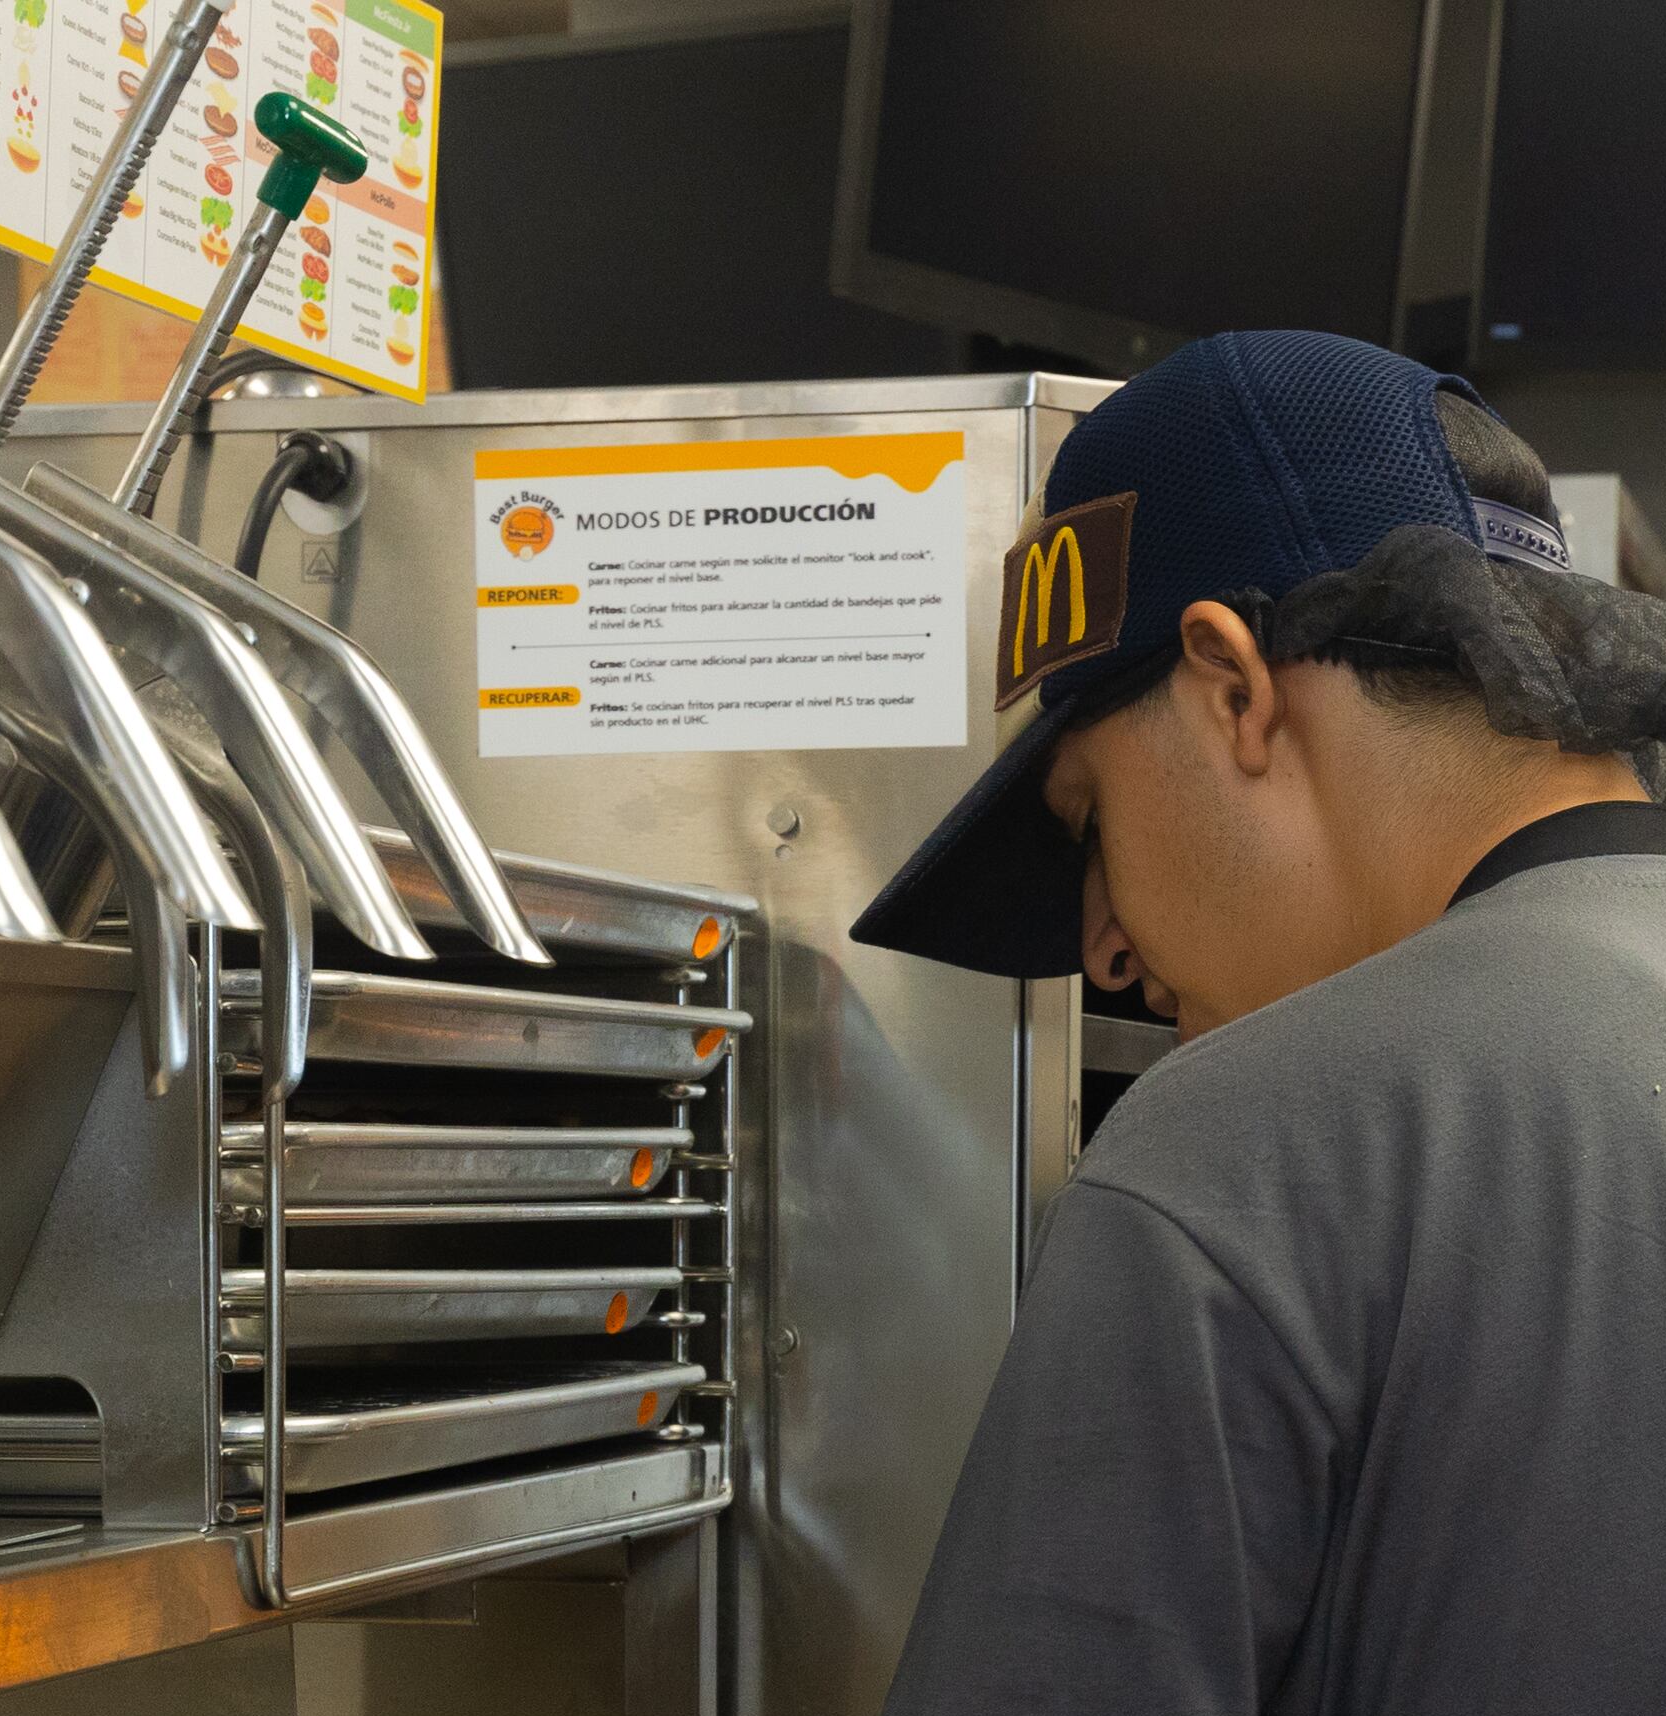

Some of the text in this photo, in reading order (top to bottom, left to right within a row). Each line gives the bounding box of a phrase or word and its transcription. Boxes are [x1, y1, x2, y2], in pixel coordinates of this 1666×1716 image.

[489, 490, 565, 525] Best Burger
[575, 498, 876, 531] MODOS DE PRODUCCIÓN
[586, 560, 625, 572] Carne:
[626, 559, 666, 570] Cocinar
[668, 559, 697, 569] carne
[698, 556, 731, 570] según
[732, 557, 750, 566] me
[750, 554, 789, 566] solicite
[790, 553, 801, 565] el
[802, 552, 845, 564] monitor
[877, 550, 898, 561] and
[587, 571, 723, 588] para reponer el nivel base.
[487, 588, 564, 603] REPONER:
[587, 593, 942, 616] Fritos: Cocinar fritos para alcanzar la cantidad de bandejas que pide
[588, 617, 664, 630] el nivel de PLS.
[588, 650, 926, 670] Carne: Cocinar carne adicional para alcanzar un nivel base mayor
[588, 671, 655, 686] según el PLS.
[489, 691, 574, 706] RECUPERAR:
[588, 693, 915, 713] Fritos: Se cocinan fritos para recuperar el nivel PLS tras quedar
[589, 713, 709, 729] sin producto en el UHC.
